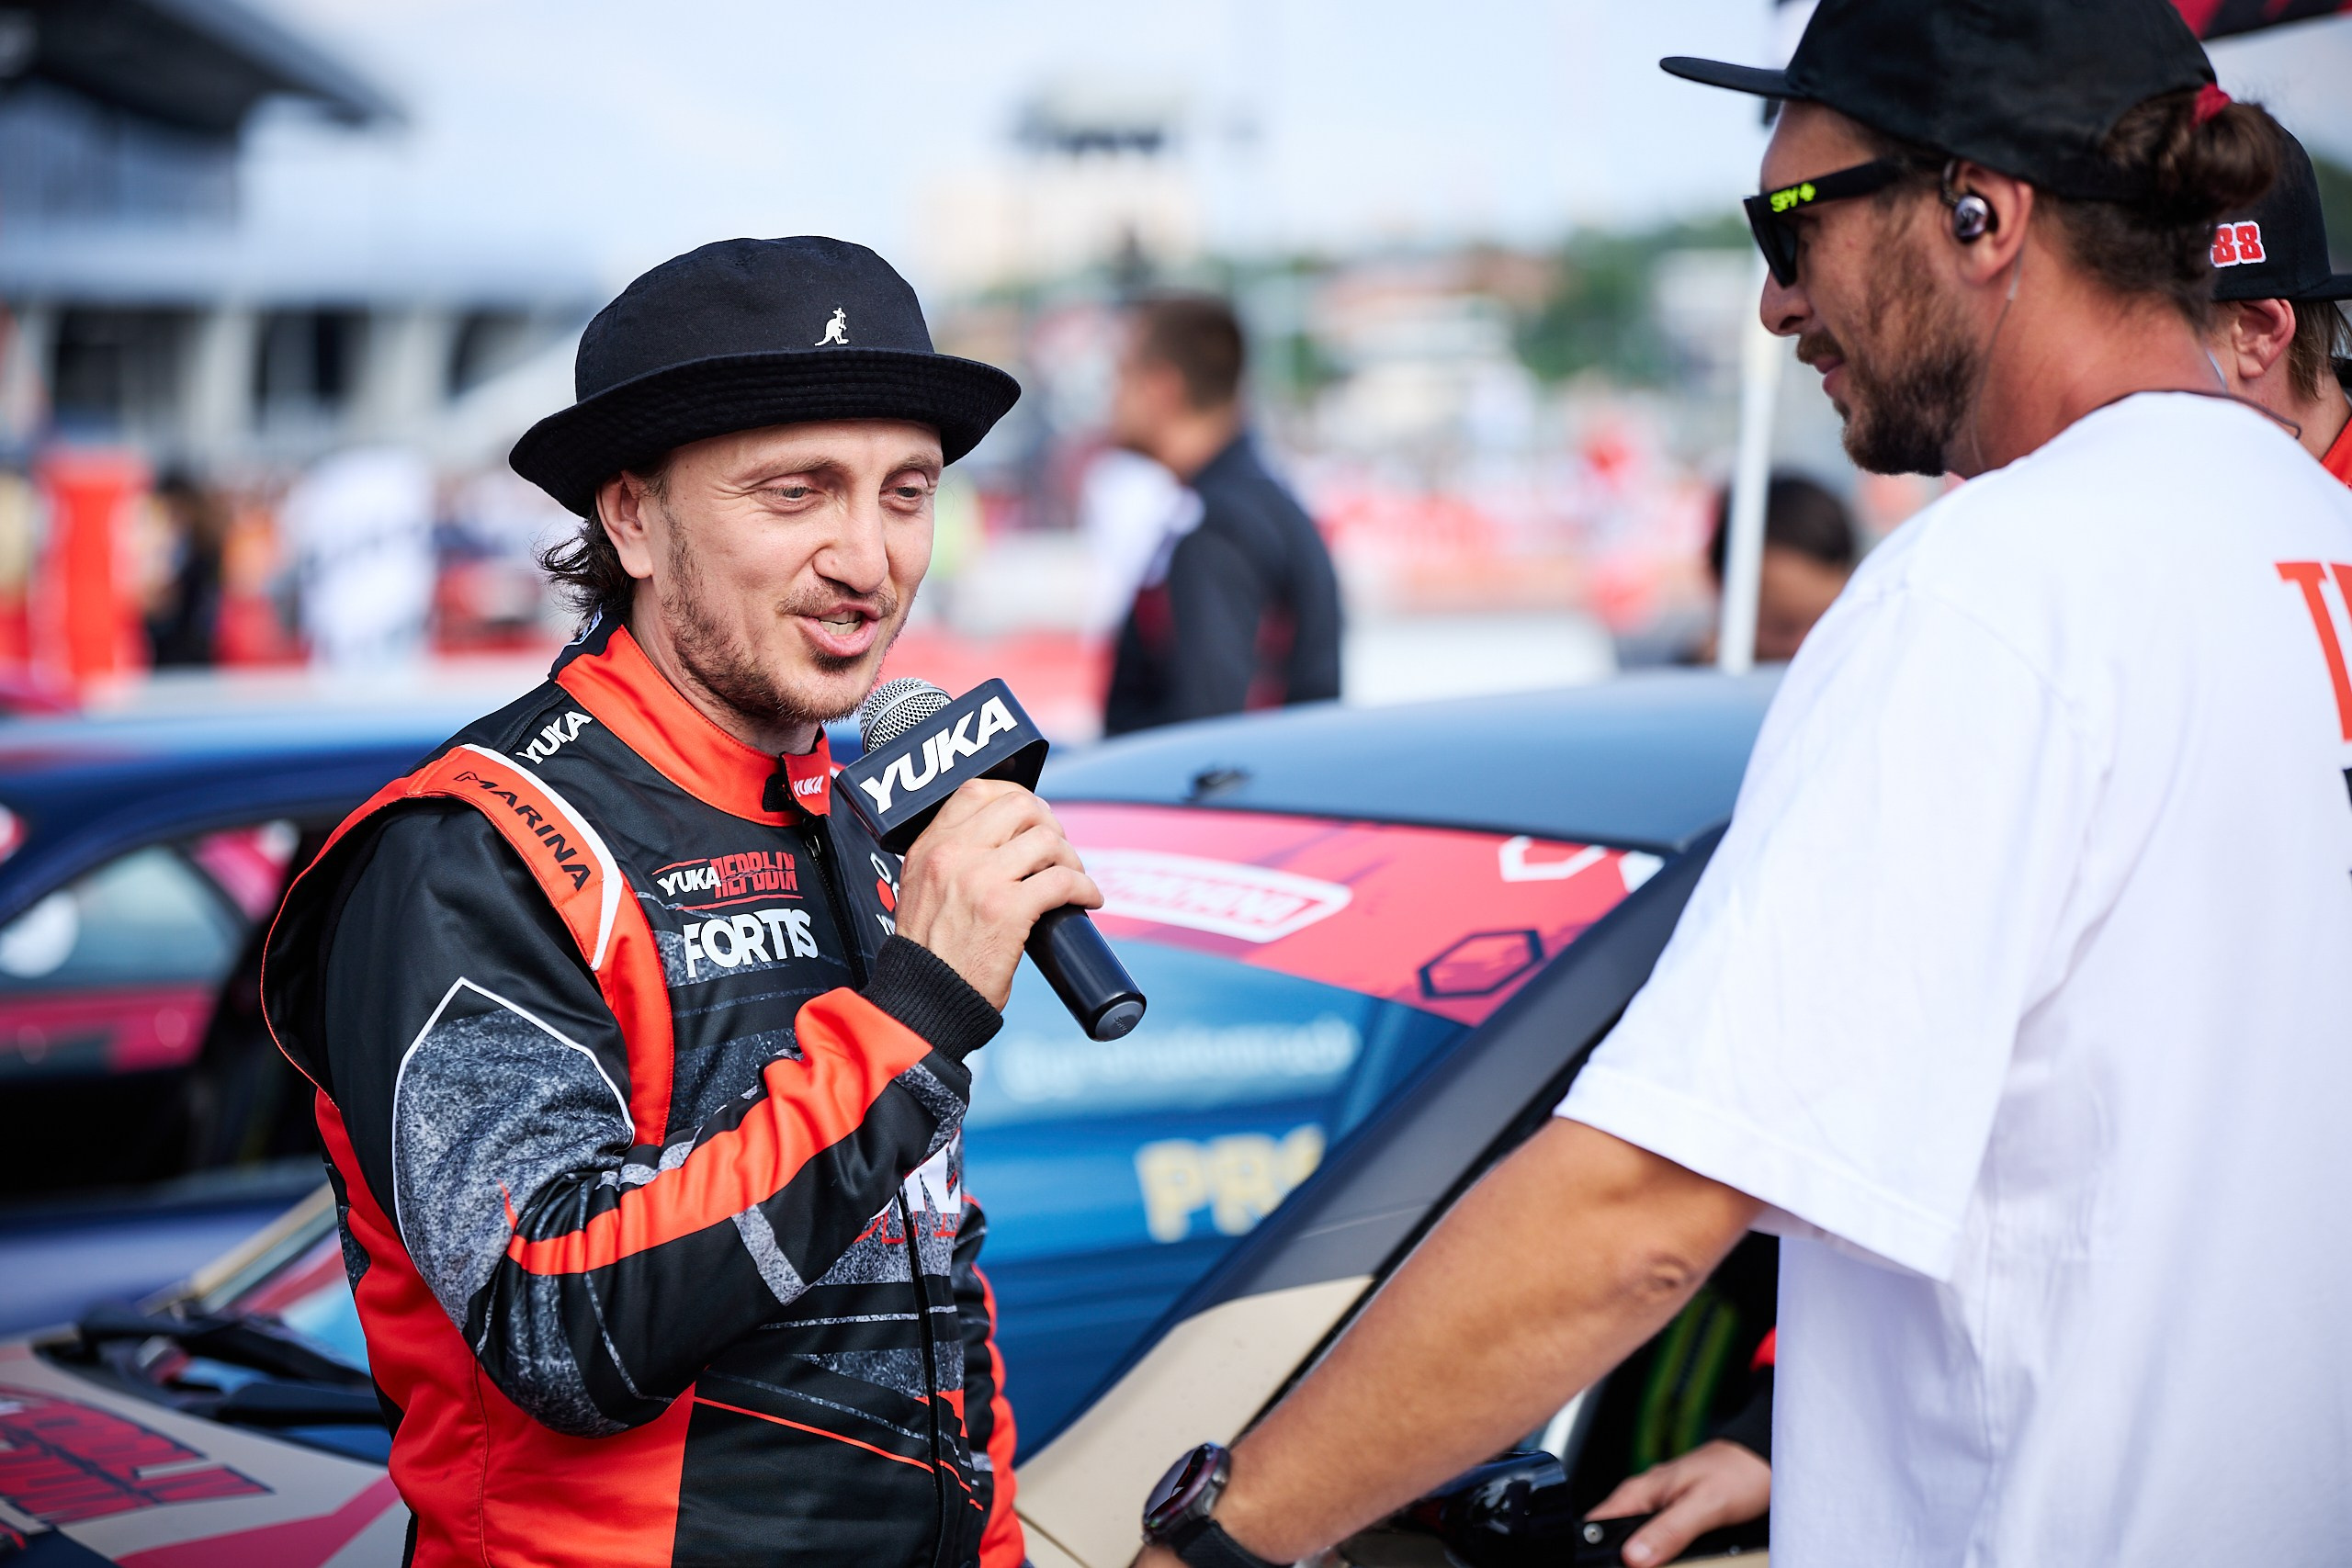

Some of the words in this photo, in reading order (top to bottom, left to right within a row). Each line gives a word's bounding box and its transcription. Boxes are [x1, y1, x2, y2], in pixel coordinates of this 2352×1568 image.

[2210, 220, 2267, 268] 88
[515, 710, 594, 764] YUKA
[859, 695, 1018, 815] YUKA
[793, 775, 824, 797] YUKA
[453, 771, 592, 891] MARINA
[656, 866, 722, 897] YUKA
[683, 908, 819, 978] FORTIS
